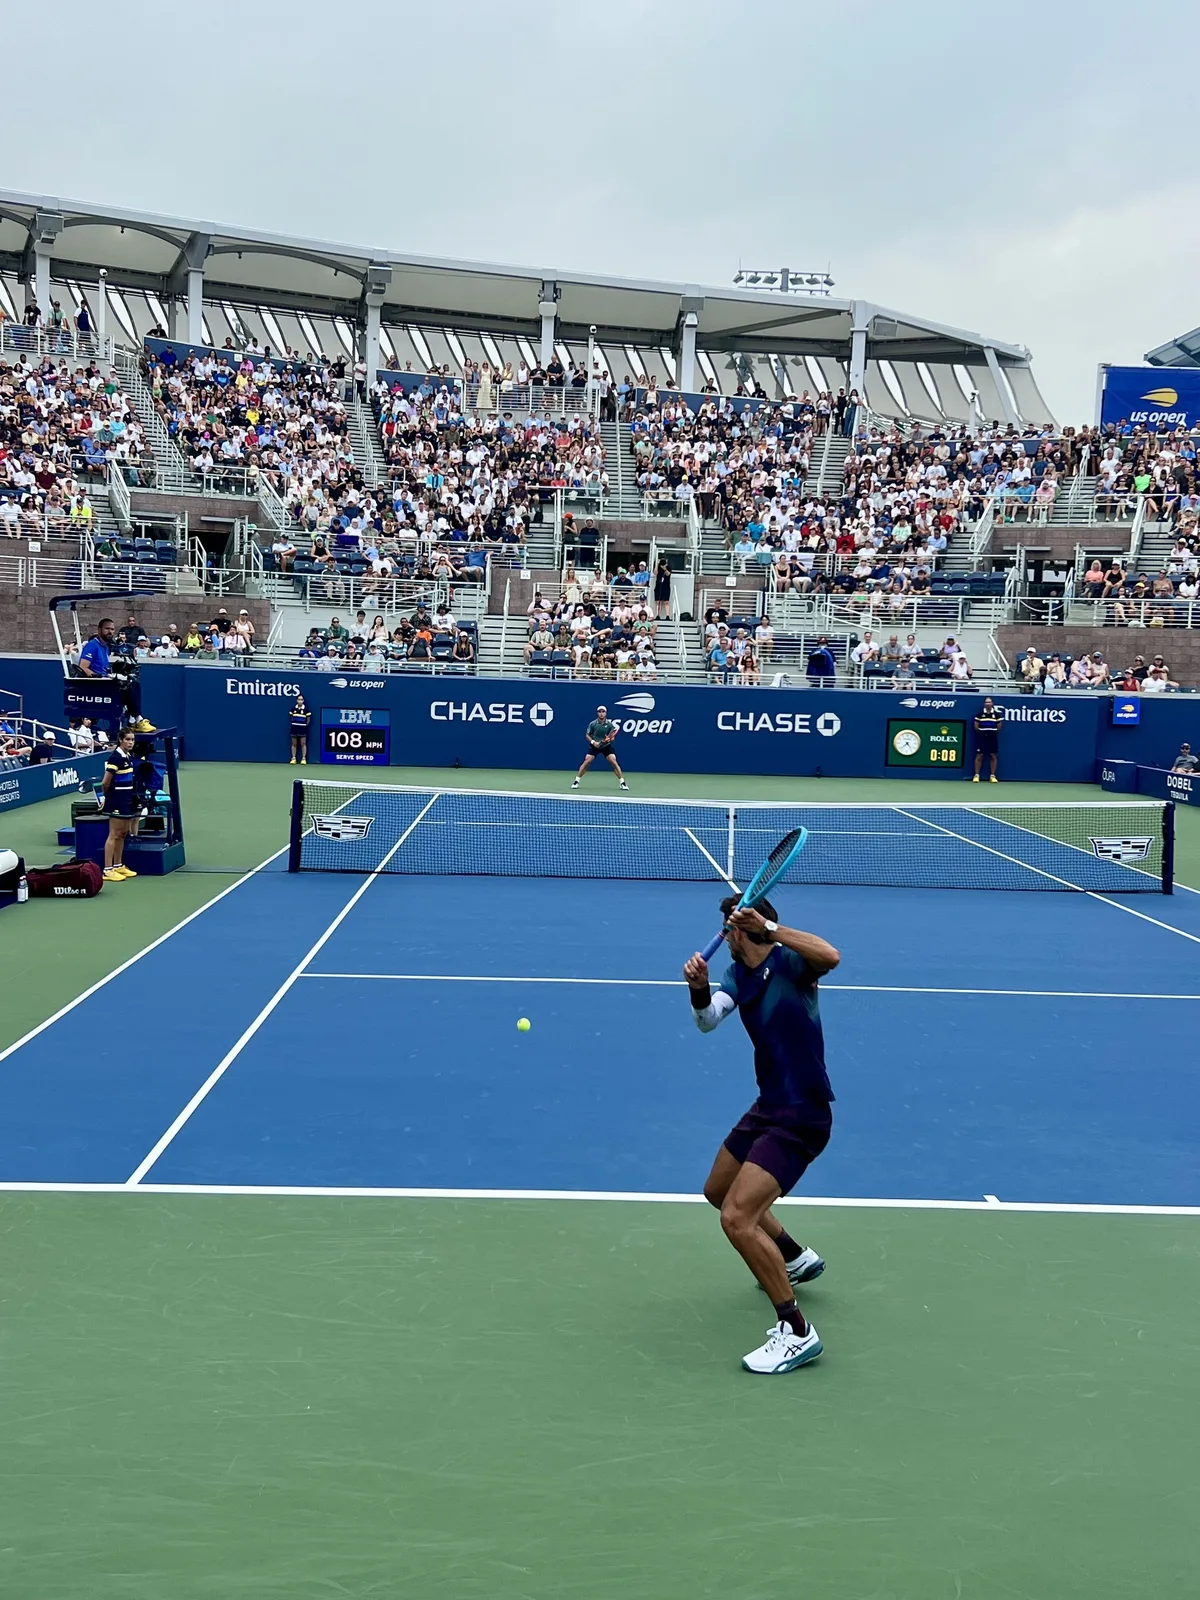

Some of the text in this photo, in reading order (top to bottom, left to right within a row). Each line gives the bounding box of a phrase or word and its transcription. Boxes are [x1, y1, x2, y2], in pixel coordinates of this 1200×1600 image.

[1130, 411, 1186, 426] us open
[226, 678, 300, 697] Emirates
[349, 680, 384, 690] us open
[67, 694, 112, 703] CHUBB
[920, 699, 955, 709] us open
[339, 709, 372, 724] IBM
[430, 701, 524, 723] CHASE
[622, 718, 673, 738] open
[717, 711, 811, 734] CHASE
[329, 731, 383, 749] 108 MPH
[929, 735, 959, 743] ROLEX
[930, 749, 957, 762] 0:08
[1167, 775, 1193, 791] DOBEL
[1170, 790, 1189, 801] TEQUILA
[53, 886, 87, 895] Wilson
